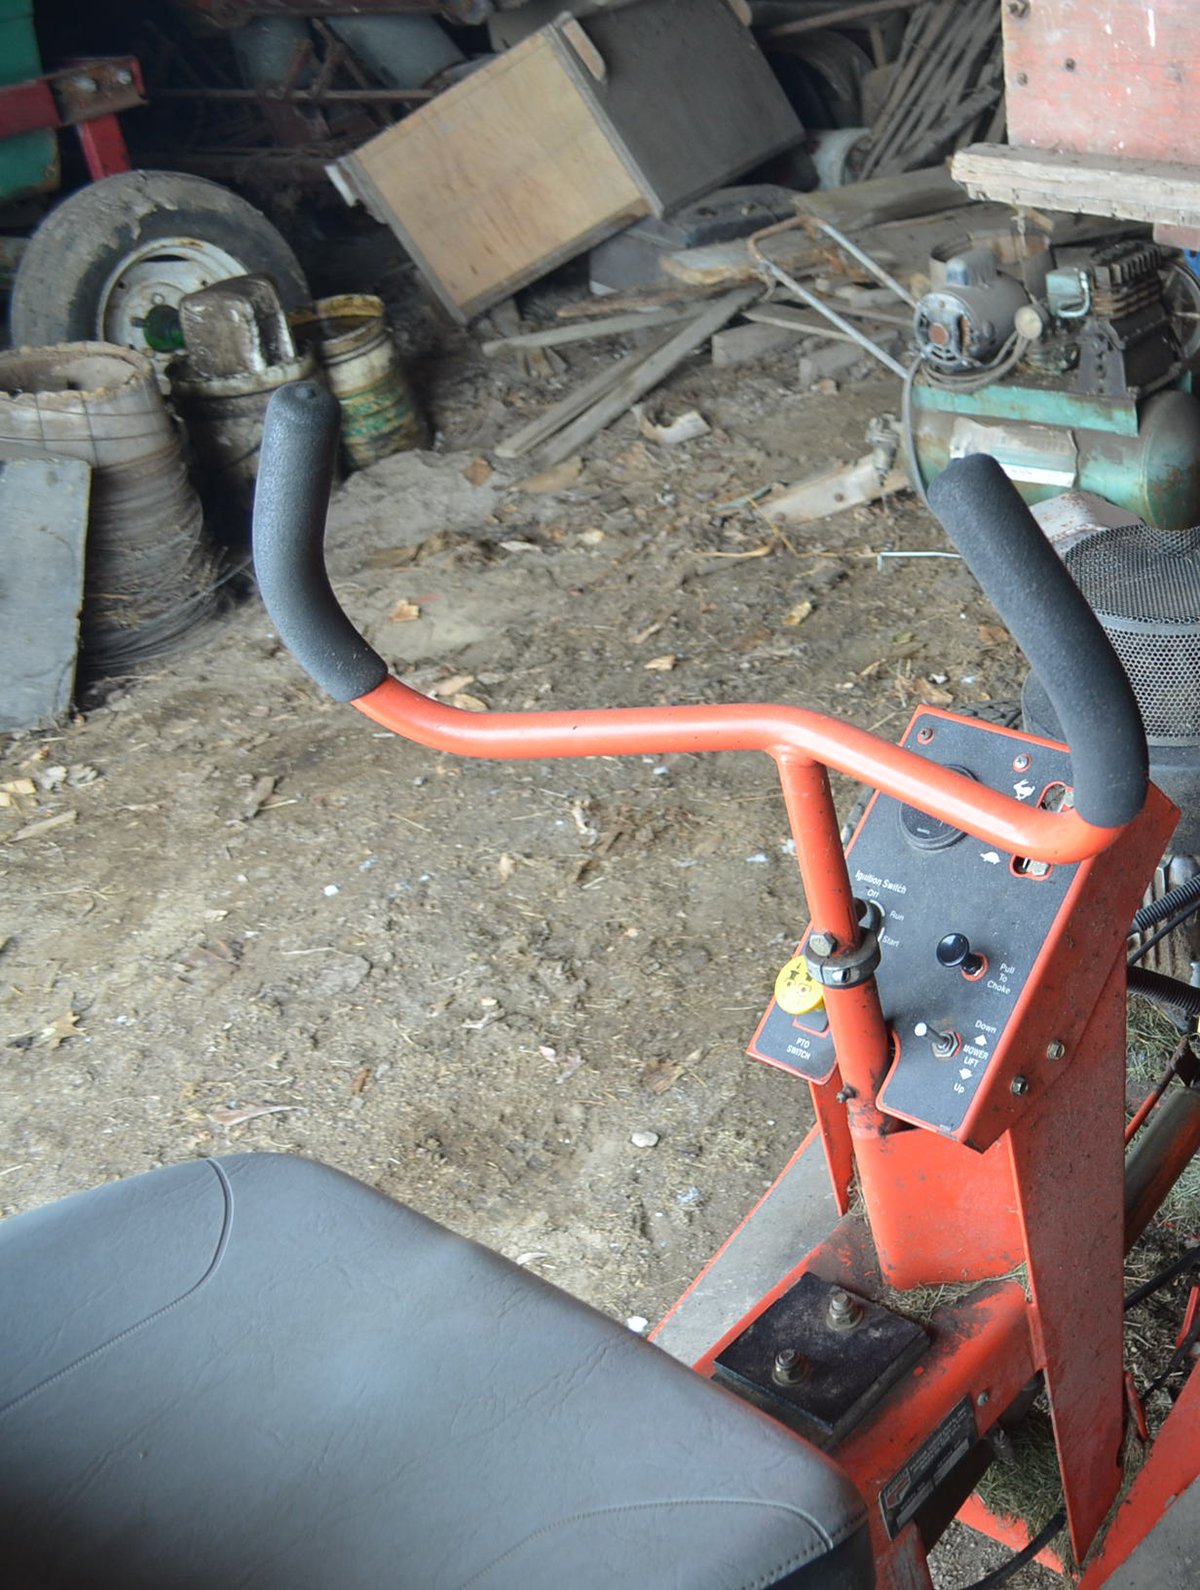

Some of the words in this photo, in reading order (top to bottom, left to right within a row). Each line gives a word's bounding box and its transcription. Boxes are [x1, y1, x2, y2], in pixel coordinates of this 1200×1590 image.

[855, 869, 882, 886] Ignition
[881, 879, 907, 895] Switch
[889, 910, 904, 921] Run
[882, 935, 900, 947] Start
[1000, 963, 1015, 974] Pull
[1000, 973, 1008, 983] To
[987, 980, 1011, 995] Choke
[975, 1019, 997, 1034] Down
[796, 1037, 810, 1049] PTO
[786, 1045, 811, 1060] SWITCH
[963, 1044, 989, 1060] MOWER
[964, 1056, 979, 1068] LIFT
[953, 1082, 965, 1093] Up
